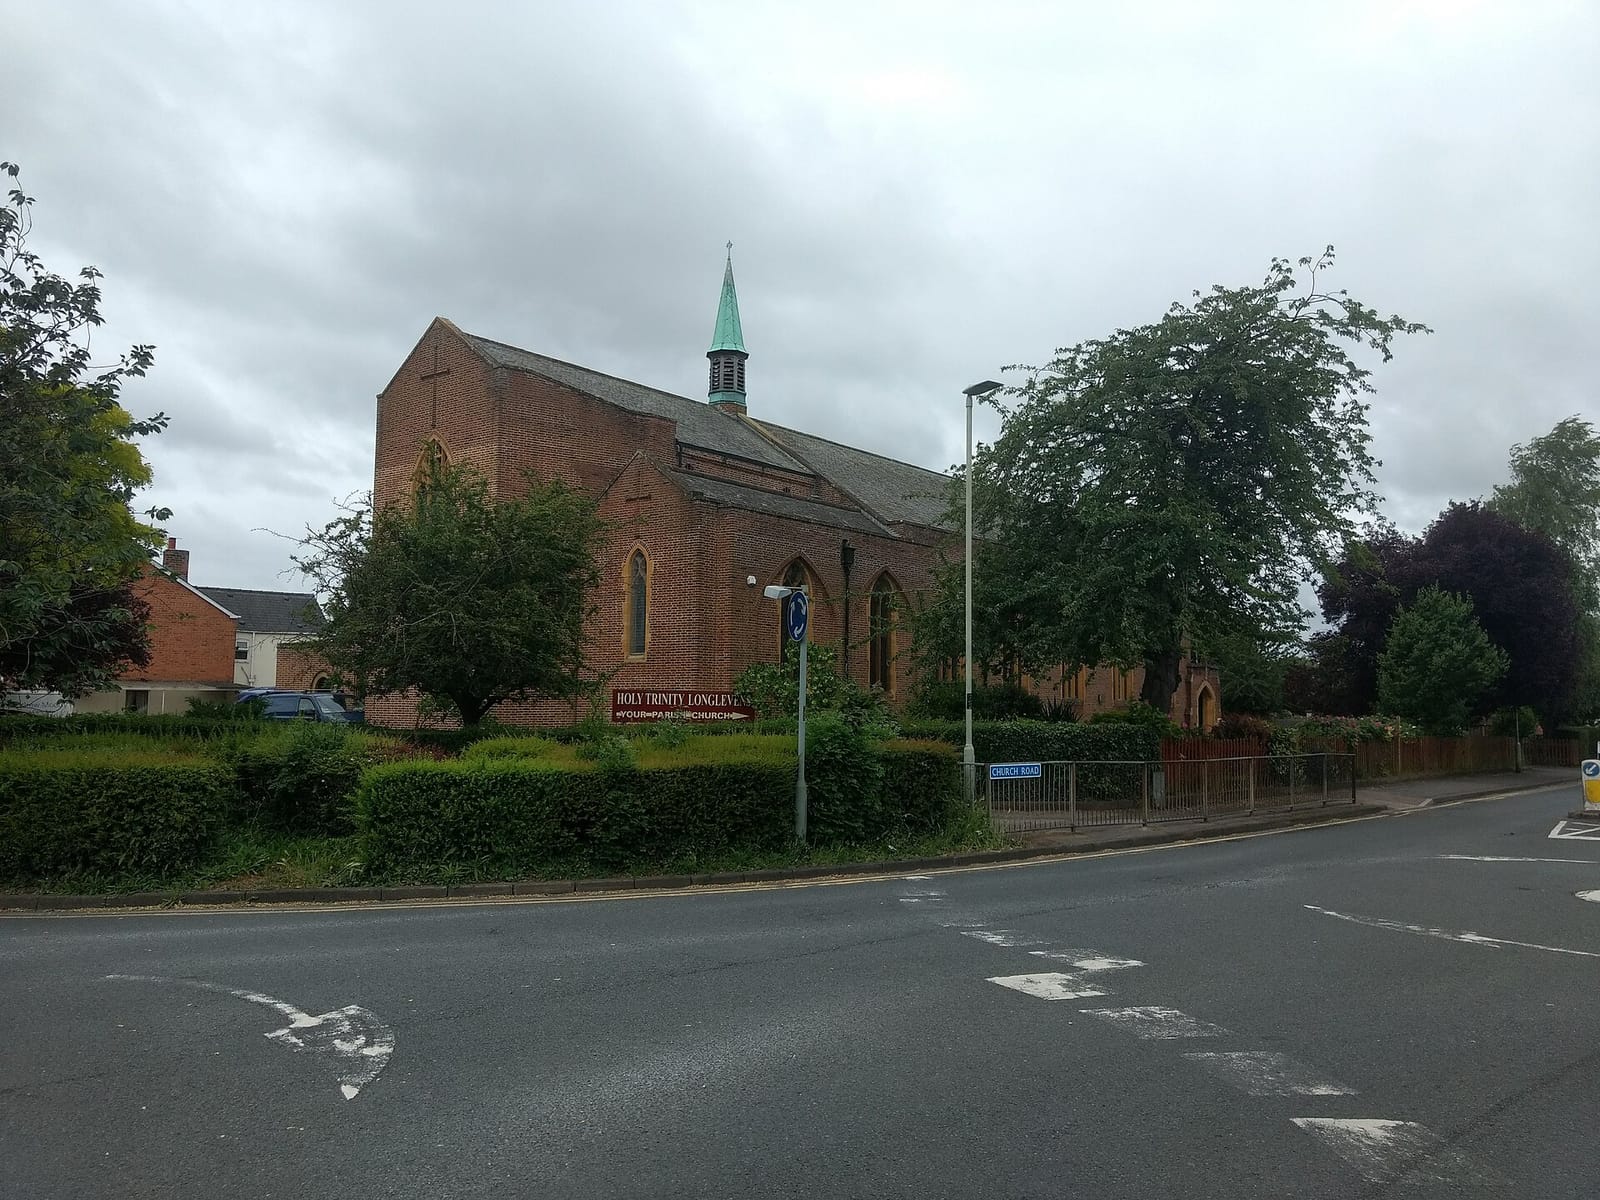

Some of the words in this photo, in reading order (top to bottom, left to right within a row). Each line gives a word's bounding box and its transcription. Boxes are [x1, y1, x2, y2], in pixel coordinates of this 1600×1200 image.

[617, 692, 644, 705] HOLY
[645, 692, 685, 706] TRINITY
[621, 710, 647, 719] YOUR
[691, 711, 730, 720] CHURCH
[992, 767, 1018, 776] CHURCH
[1021, 766, 1039, 775] ROAD
